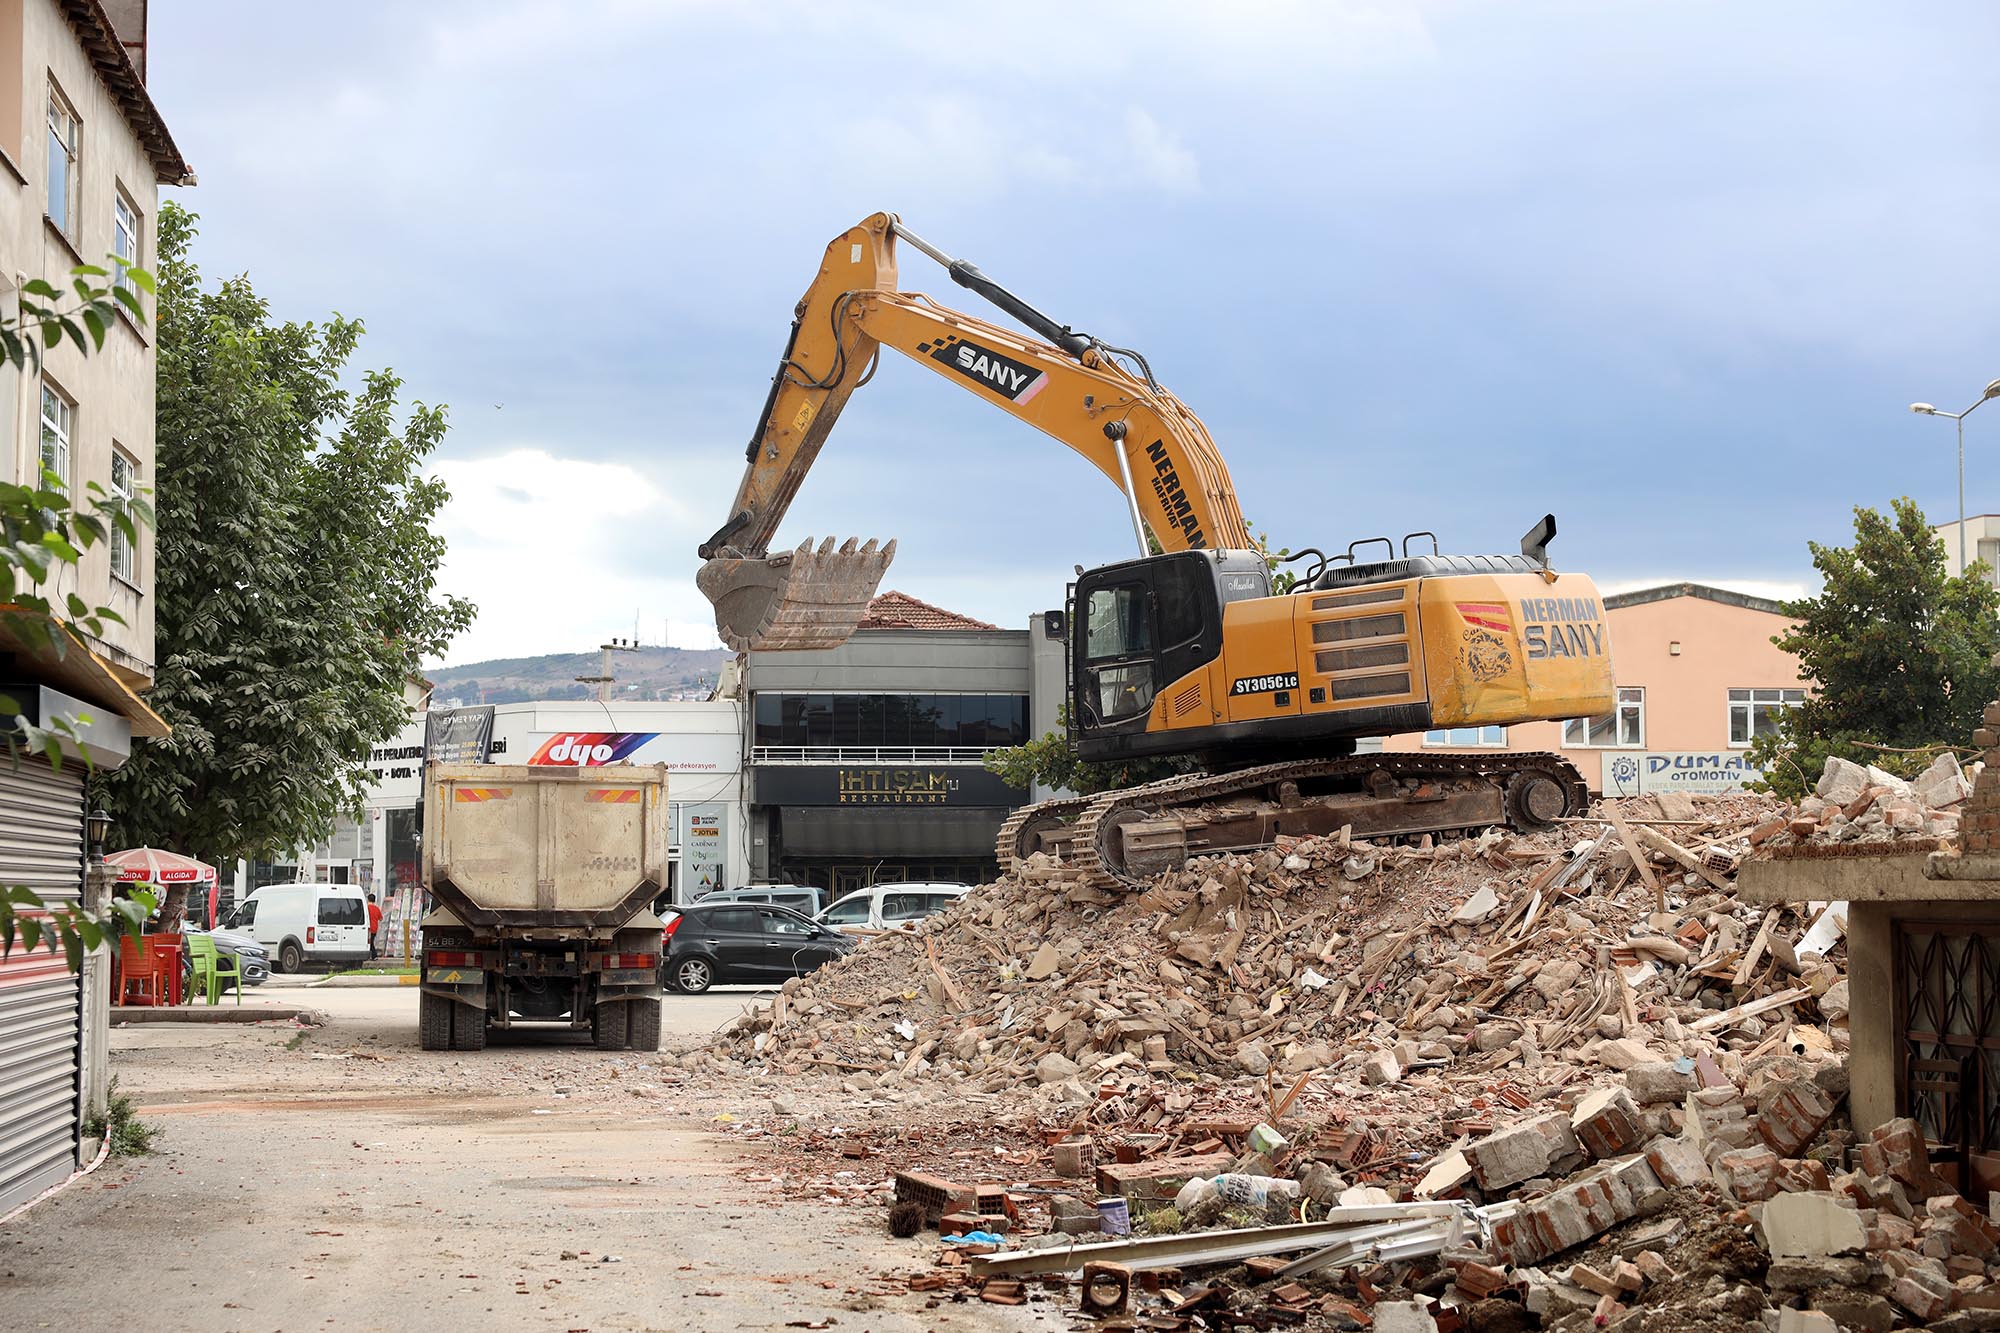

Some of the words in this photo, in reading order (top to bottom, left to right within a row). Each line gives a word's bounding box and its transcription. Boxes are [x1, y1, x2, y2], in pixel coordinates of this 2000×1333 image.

[956, 345, 1028, 392] SANY
[1145, 438, 1207, 549] NERMAN
[1520, 598, 1599, 622] NERMAN
[1524, 624, 1602, 660] SANY
[549, 736, 614, 766] dyo
[680, 762, 717, 770] dekorasyon
[1671, 771, 1741, 781] OTOMOTİV
